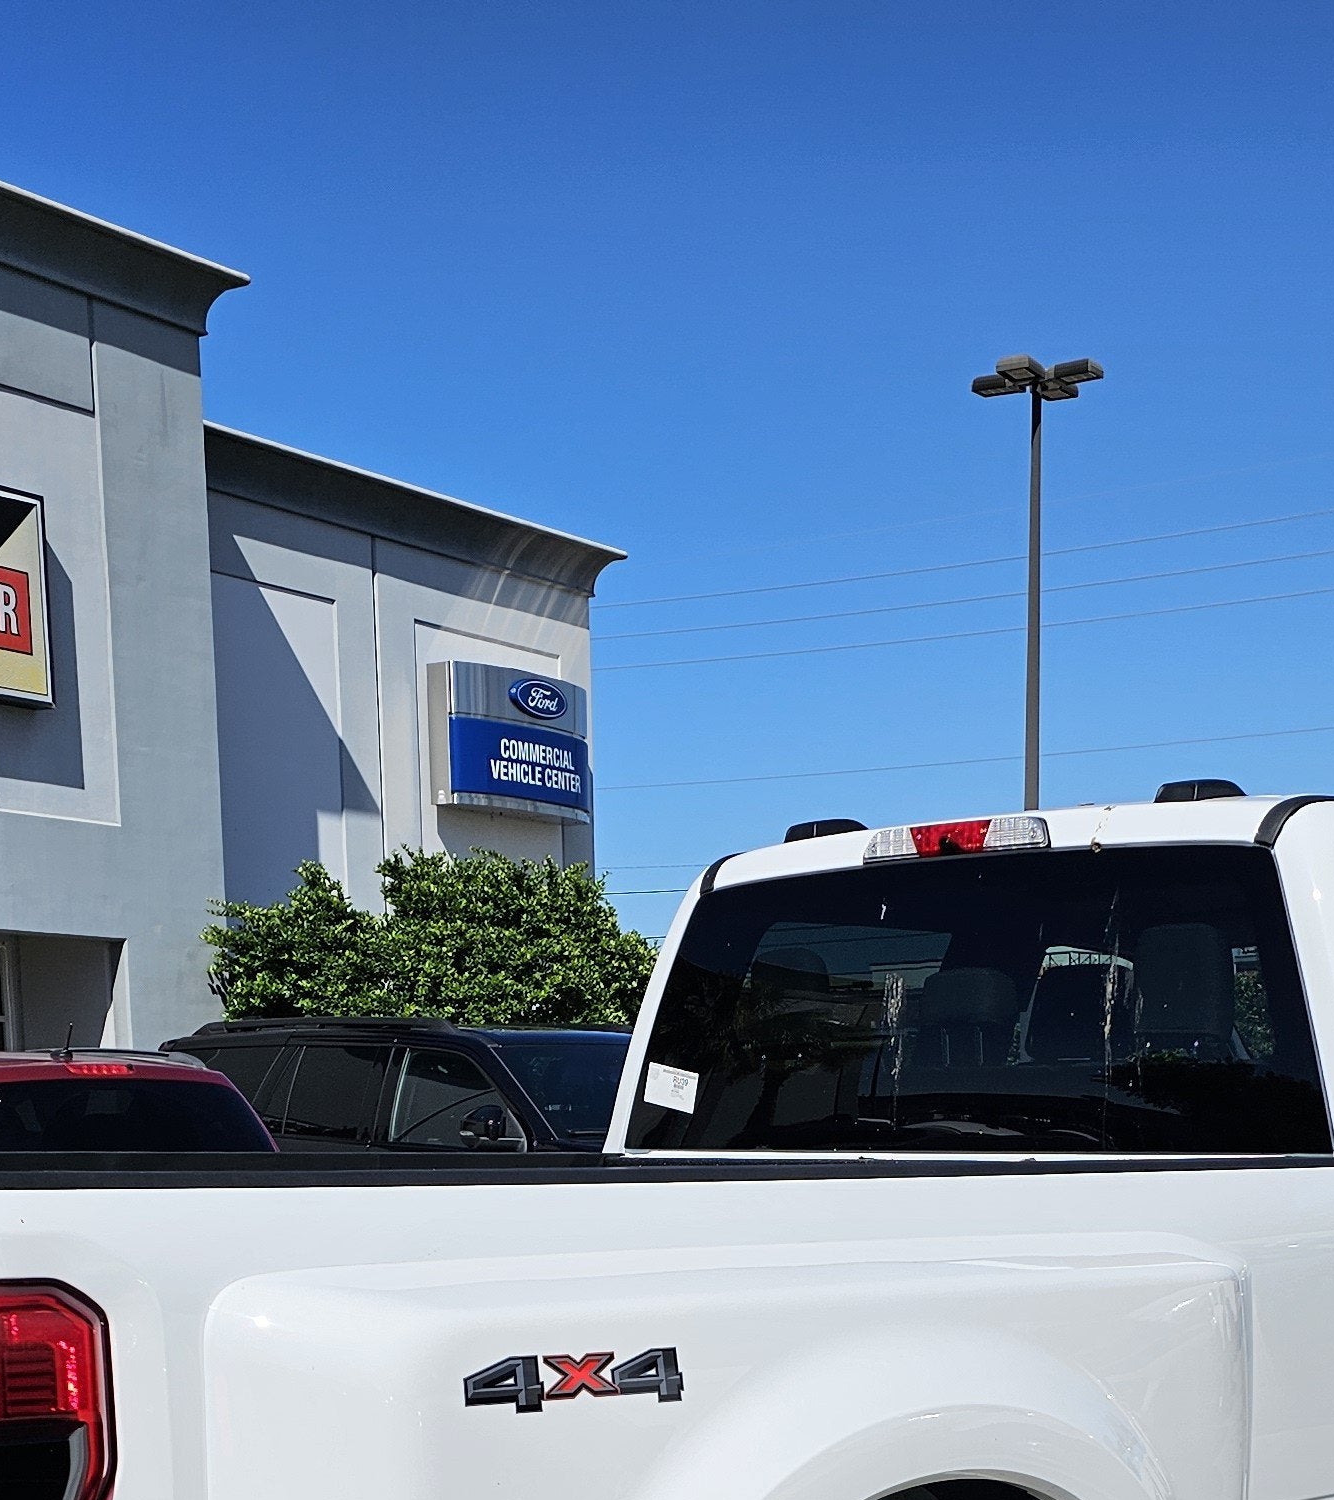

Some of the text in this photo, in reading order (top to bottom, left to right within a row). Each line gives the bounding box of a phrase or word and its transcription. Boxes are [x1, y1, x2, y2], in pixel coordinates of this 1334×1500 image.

[527, 687, 559, 712] Ford
[500, 738, 575, 771] COMMERCIAL
[490, 759, 581, 794] VEHICLE CENTER
